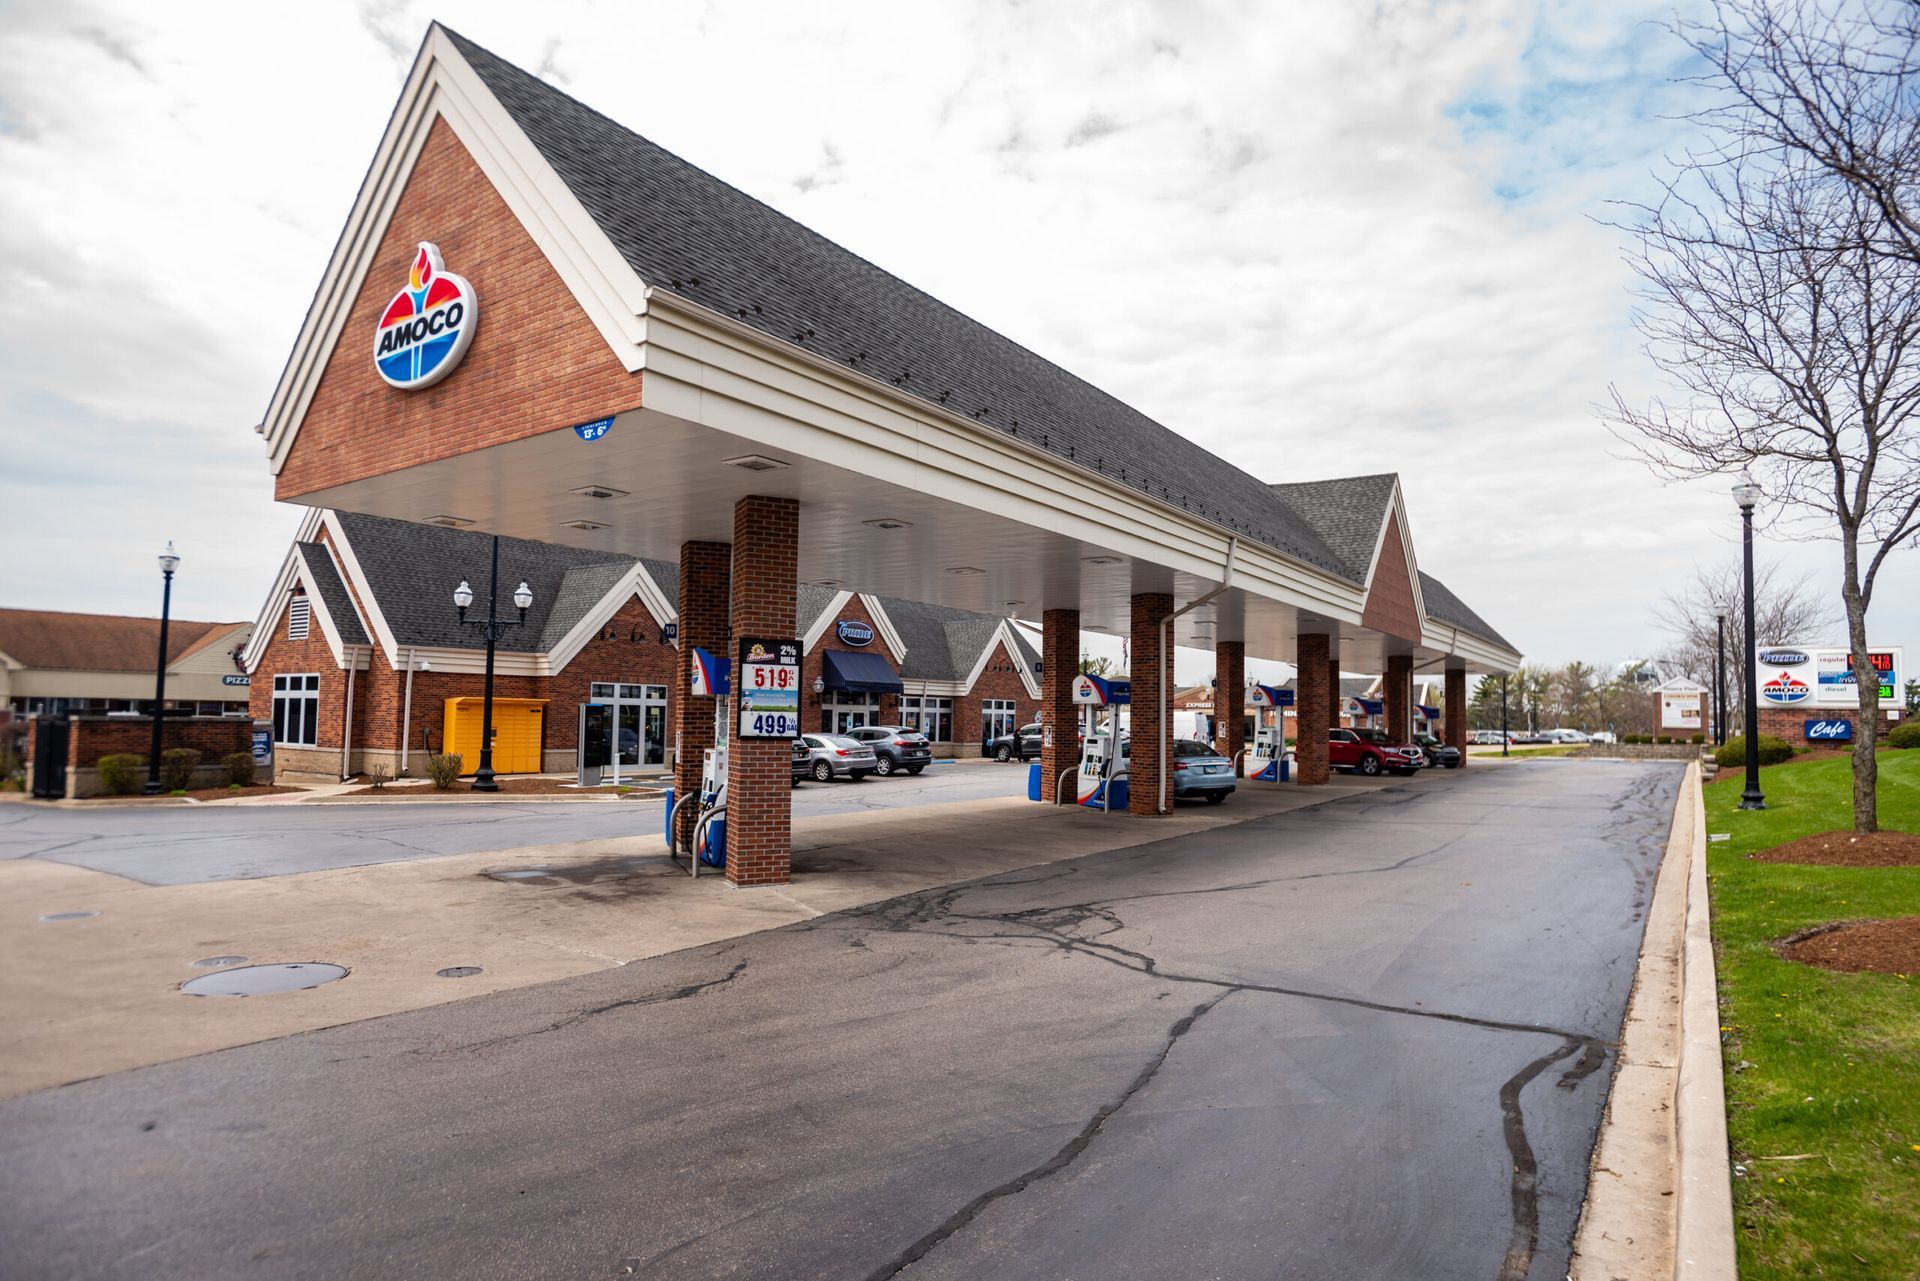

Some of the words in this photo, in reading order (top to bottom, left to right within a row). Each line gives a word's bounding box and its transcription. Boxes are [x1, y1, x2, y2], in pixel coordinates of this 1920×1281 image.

[377, 302, 463, 357] AMOCO
[665, 626, 675, 635] 10
[842, 627, 872, 640] PRIDE
[749, 652, 775, 661] Borden
[780, 645, 797, 656] 2%
[780, 656, 796, 665] MILK
[1763, 655, 1806, 663] PRIDE
[754, 668, 788, 688] 519
[753, 714, 787, 734] 499
[1810, 721, 1845, 737] Cafe
